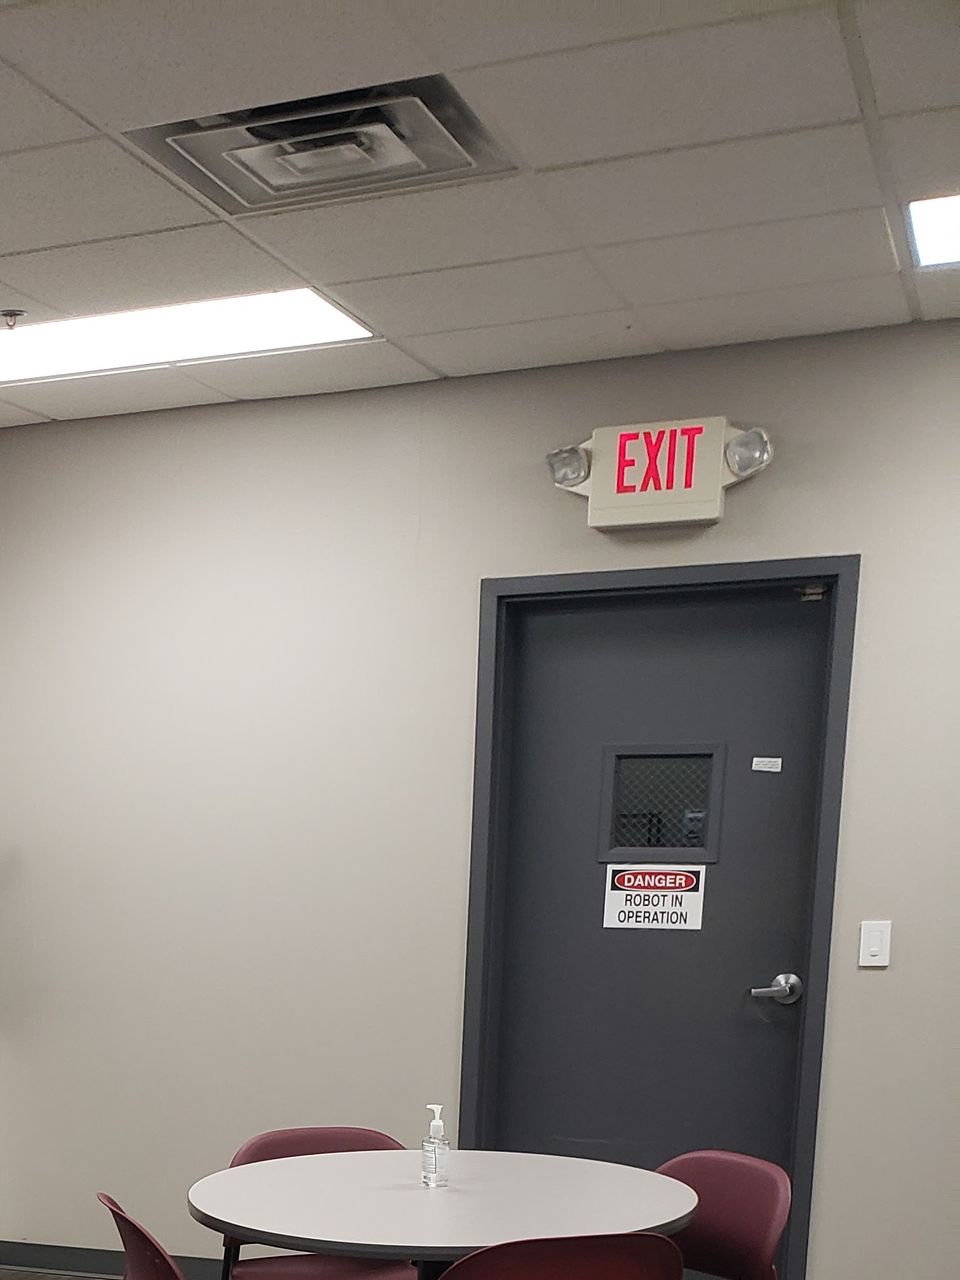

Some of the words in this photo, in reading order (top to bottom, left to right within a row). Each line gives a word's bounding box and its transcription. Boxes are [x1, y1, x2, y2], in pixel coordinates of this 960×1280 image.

[616, 426, 704, 494] EXIT
[624, 875, 686, 887] DANGER
[624, 894, 668, 907] ROBOT
[671, 895, 683, 907] IN
[617, 910, 688, 924] OPERATION
